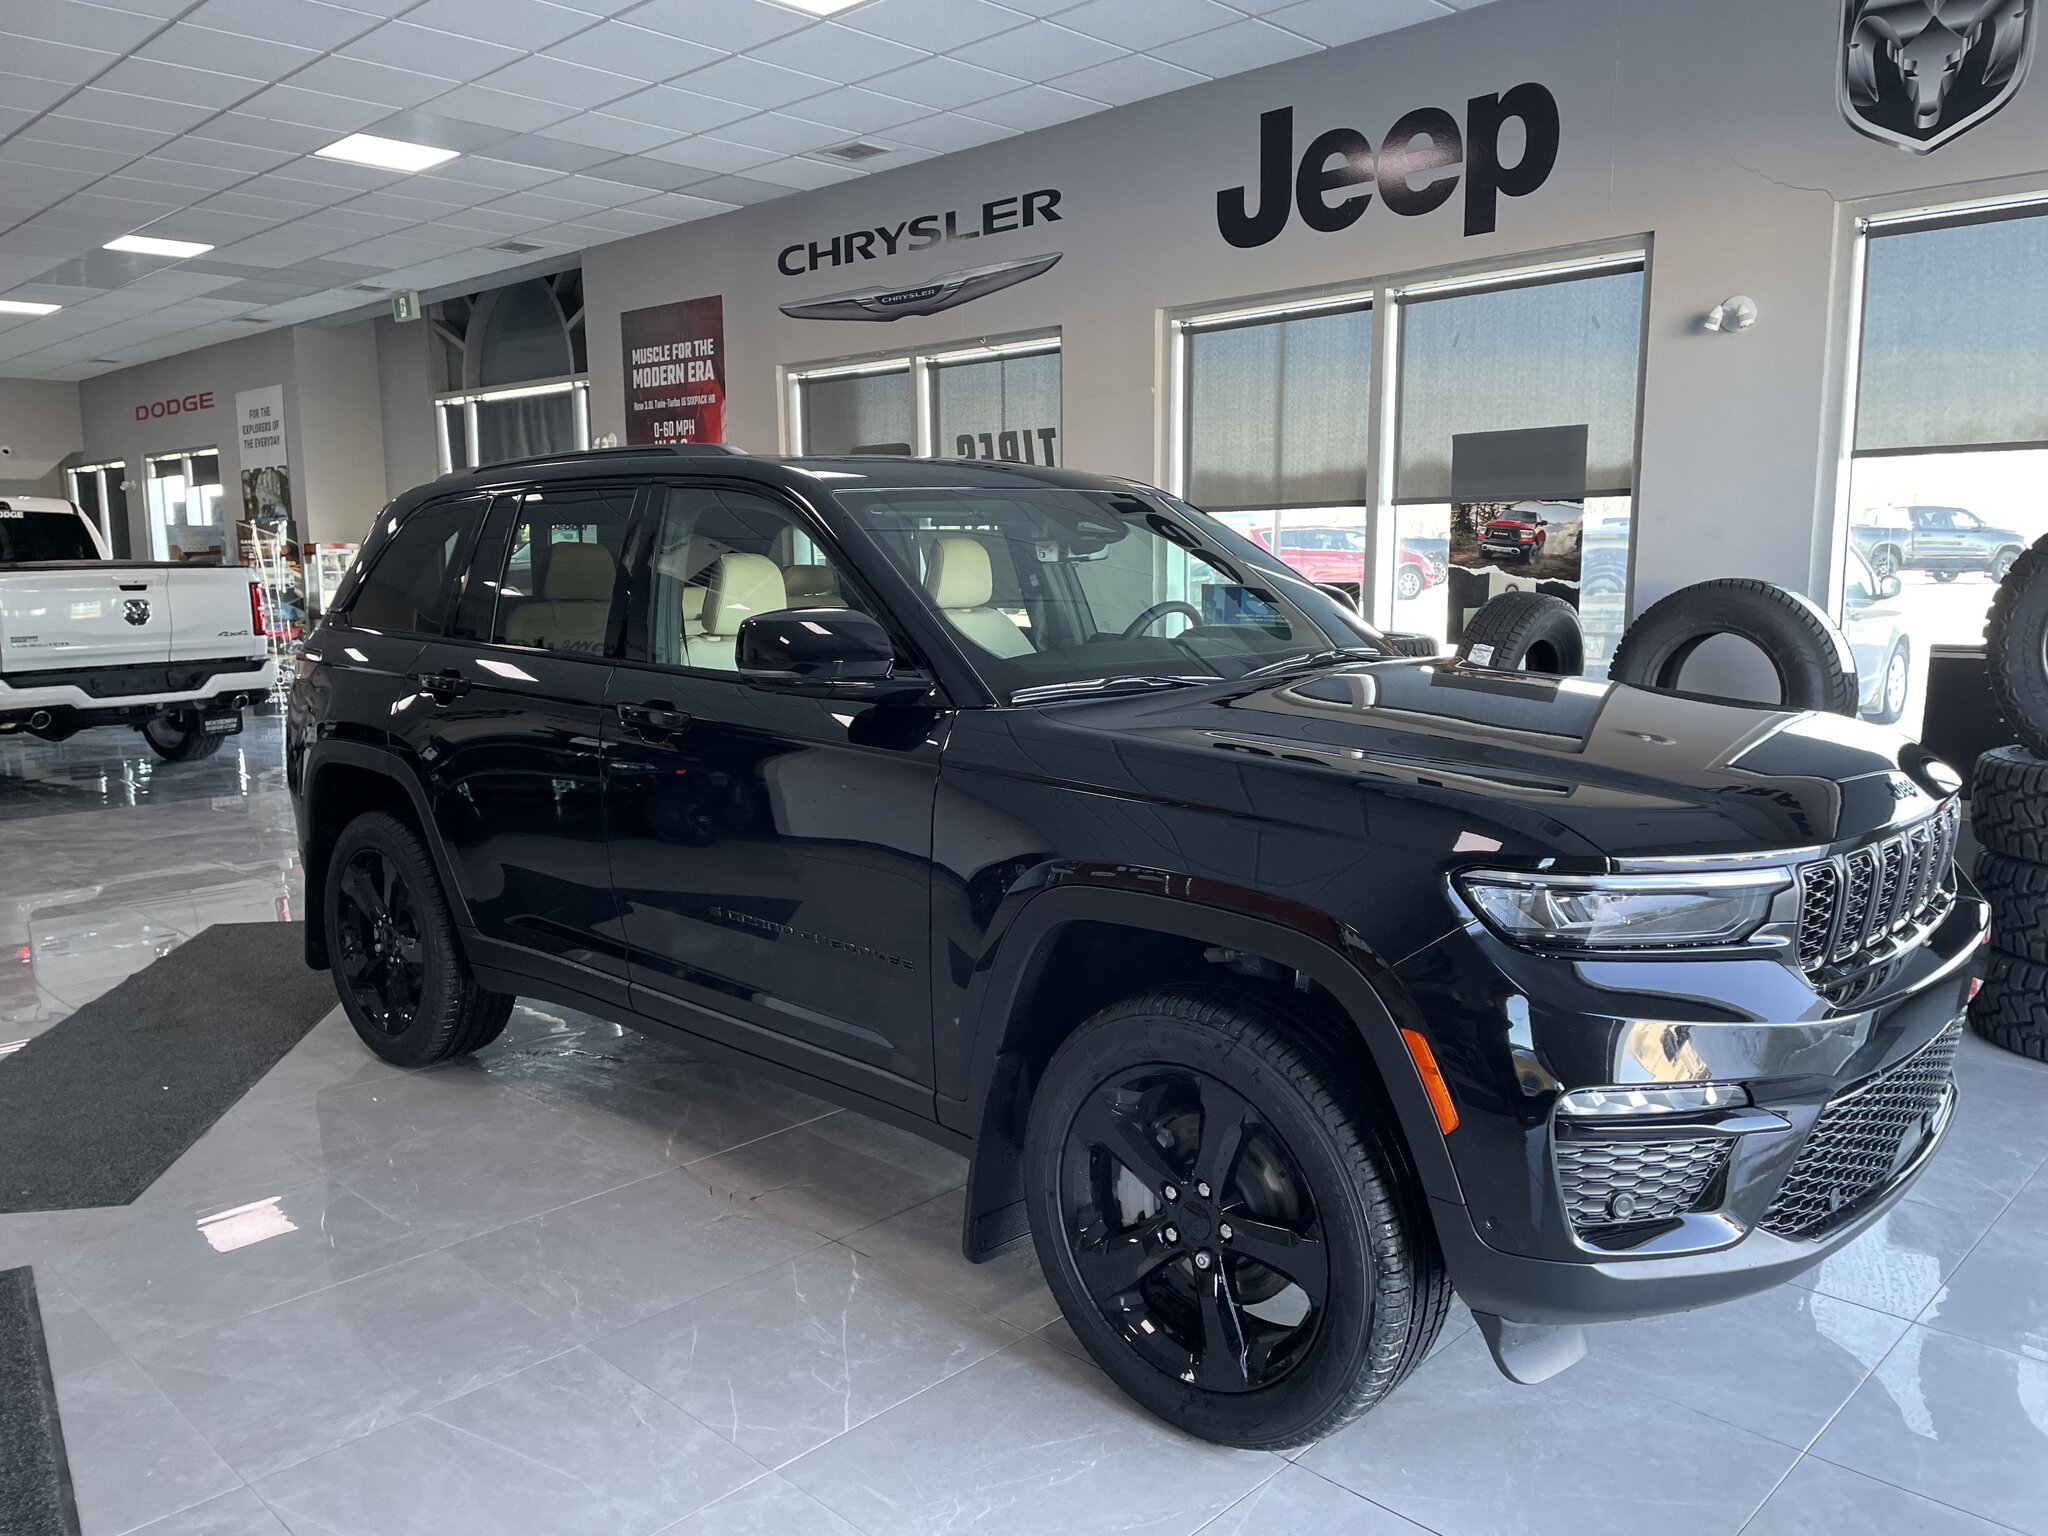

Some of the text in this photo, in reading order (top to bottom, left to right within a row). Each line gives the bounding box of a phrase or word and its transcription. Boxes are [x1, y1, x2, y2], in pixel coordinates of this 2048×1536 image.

[1217, 82, 1560, 249] Jeep
[778, 188, 1064, 276] CHRYSLER
[881, 289, 936, 303] CHRYSLER
[632, 338, 714, 365] MUSCLE FOR THE
[632, 359, 715, 389] MODERN ERA
[136, 391, 214, 421] DODGE
[655, 397, 681, 409] Twin-Turbo
[687, 394, 707, 406] SIXPACK
[249, 406, 271, 419] FOR THE
[242, 419, 280, 436] EXPLORERS OF
[654, 418, 695, 438] 0-60 MPH
[244, 435, 281, 449] THE EVERYDAY
